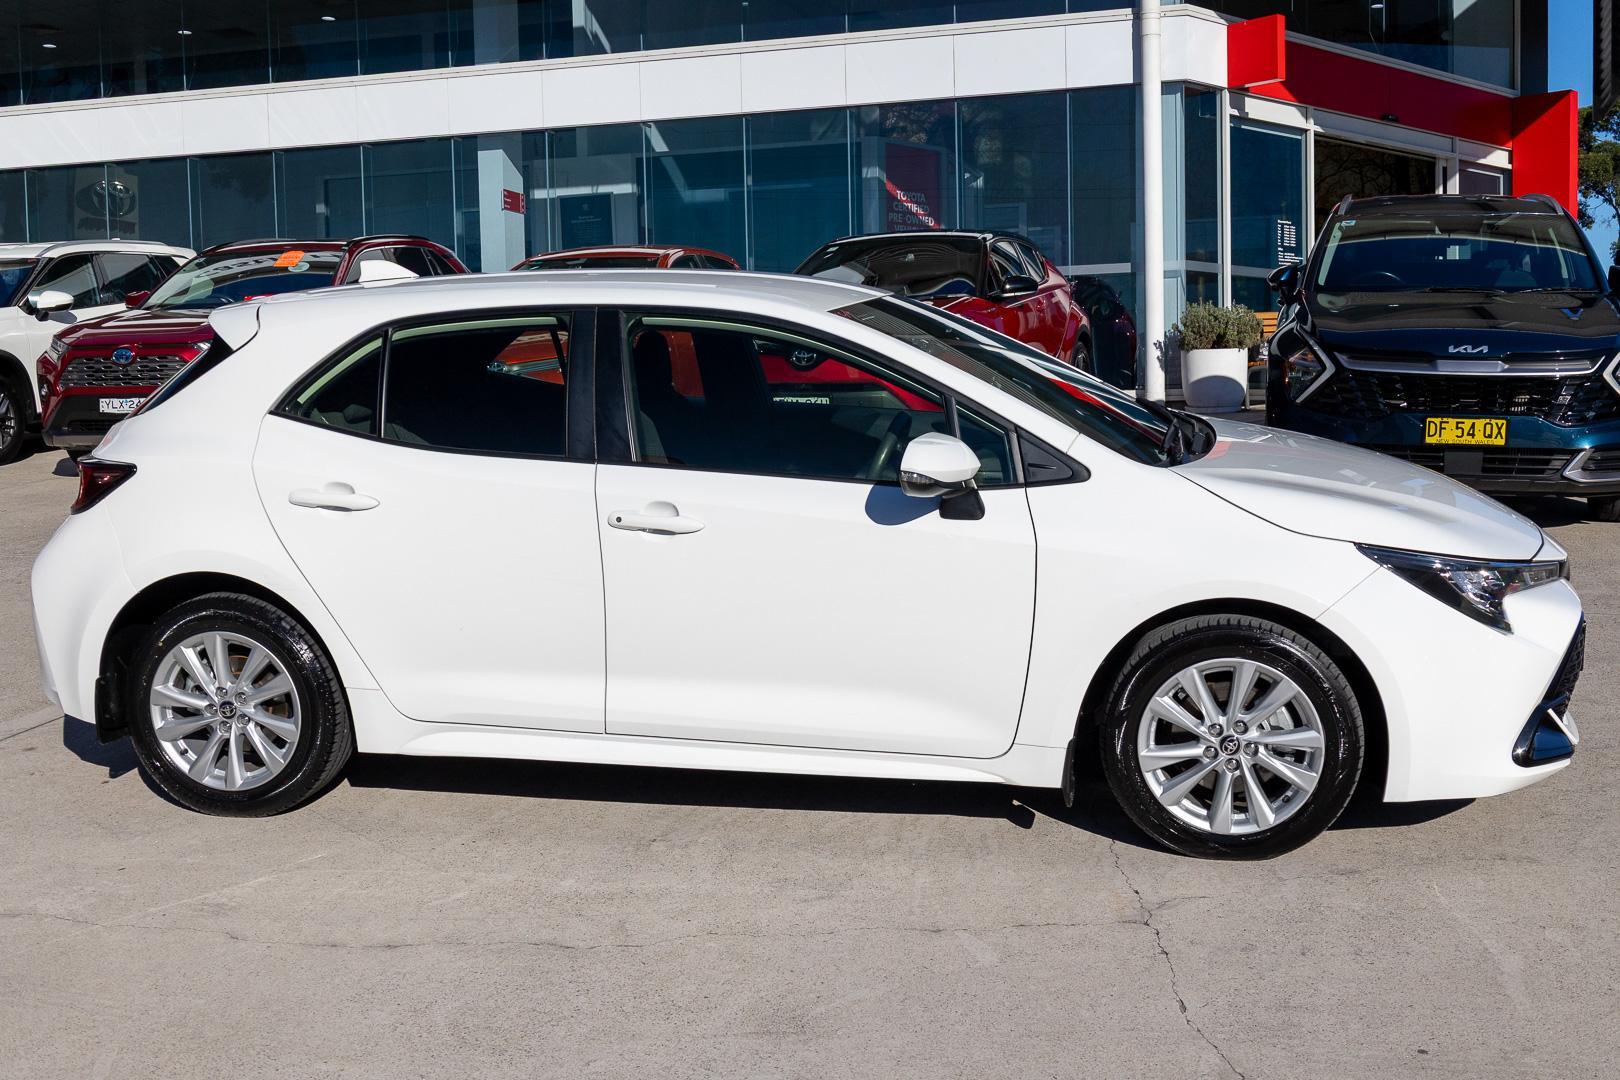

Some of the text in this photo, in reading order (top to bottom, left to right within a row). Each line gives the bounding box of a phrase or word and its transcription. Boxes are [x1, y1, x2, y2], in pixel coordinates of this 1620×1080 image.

[896, 190, 926, 202] TOYOTA
[893, 202, 929, 213] CERTIFIED
[888, 212, 935, 226] PRE-OWNED
